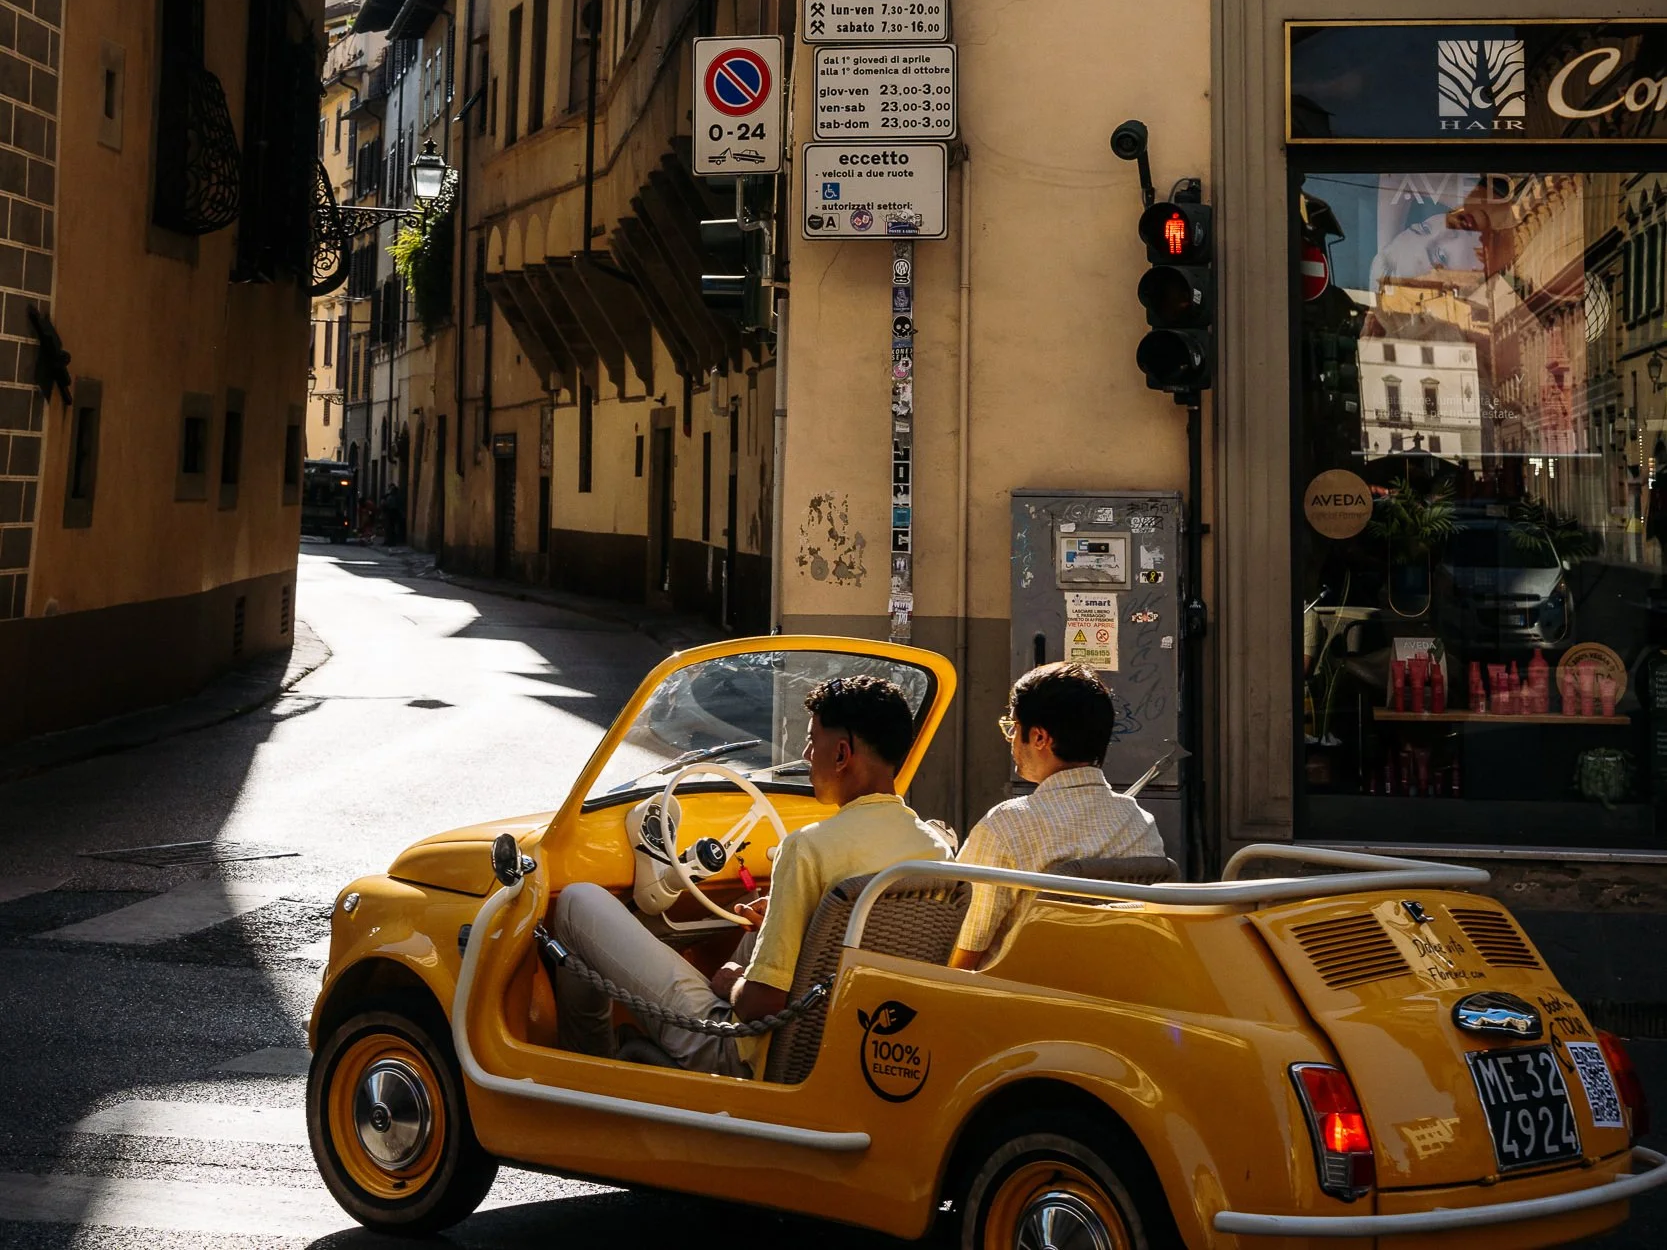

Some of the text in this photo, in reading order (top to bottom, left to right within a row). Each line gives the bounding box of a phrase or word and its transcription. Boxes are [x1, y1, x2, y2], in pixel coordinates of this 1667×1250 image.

[831, 4, 874, 15] lun-ven
[836, 21, 875, 33] sabato
[823, 56, 839, 65] dal
[853, 55, 888, 66] giovedì
[890, 55, 900, 64] di
[902, 55, 931, 65] aprile
[820, 68, 839, 76] alla
[853, 67, 899, 76] domenica
[902, 66, 911, 74] di
[915, 66, 950, 74] ottobre
[819, 86, 869, 98] giov-ven
[820, 102, 866, 113] ven-sab
[819, 119, 870, 129] sab-dom
[1440, 120, 1525, 130] HAIR
[839, 151, 909, 165] eccetto
[822, 169, 854, 178] veicoli
[866, 169, 884, 178] due
[887, 170, 914, 178] ruote
[1390, 173, 1547, 206] AVEDA
[822, 202, 913, 211] autorizzati settori:
[825, 216, 836, 228] A
[1481, 409, 1519, 420] estate.
[1311, 494, 1366, 506] AVEDA
[1403, 641, 1437, 650] AVEDA
[1554, 1016, 1592, 1037] TOUR
[872, 1040, 920, 1066] 100%
[873, 1063, 920, 1080] ELECTRIC
[1477, 1052, 1565, 1105] ME32
[1502, 1103, 1576, 1159] 4924
